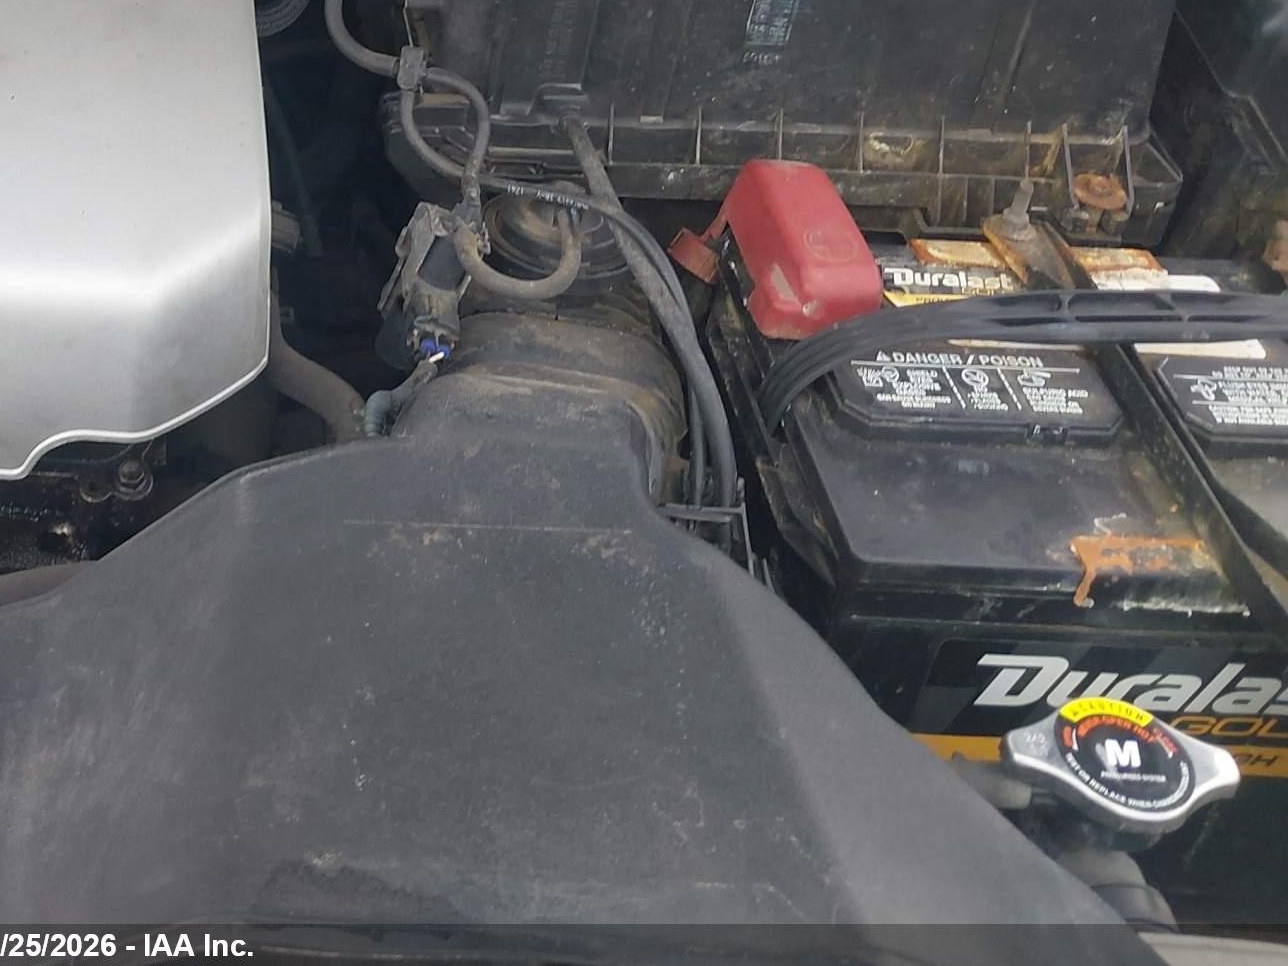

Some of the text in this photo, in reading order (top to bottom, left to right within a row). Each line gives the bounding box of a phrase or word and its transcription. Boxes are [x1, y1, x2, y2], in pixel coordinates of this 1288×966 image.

[892, 350, 963, 365] DANGER
[979, 354, 1045, 368] POISON
[1172, 714, 1288, 736] GOL
[1103, 738, 1142, 768] M
